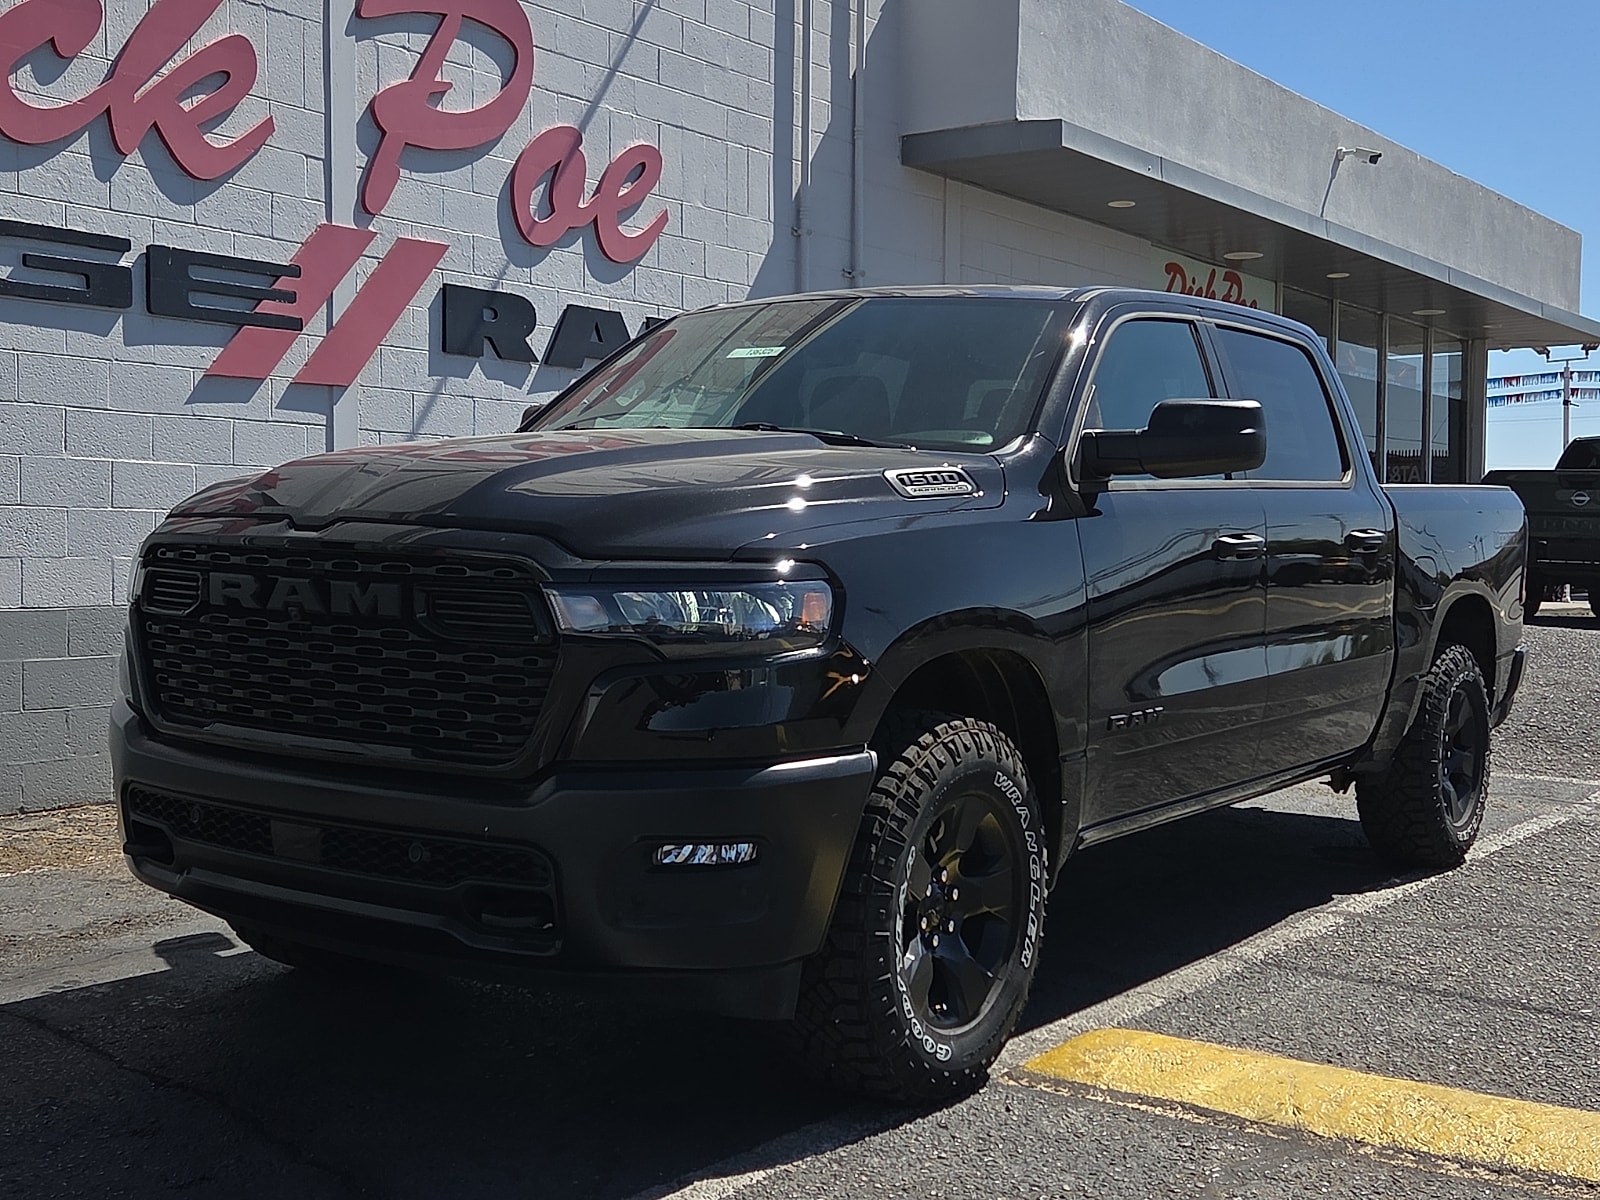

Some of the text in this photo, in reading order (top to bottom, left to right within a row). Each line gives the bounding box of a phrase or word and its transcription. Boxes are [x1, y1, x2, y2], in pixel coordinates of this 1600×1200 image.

[355, 0, 669, 264] Poe
[441, 283, 668, 369] RA
[897, 472, 960, 486] 1500
[208, 571, 402, 618] RAM
[993, 771, 1042, 968] WRANGLER
